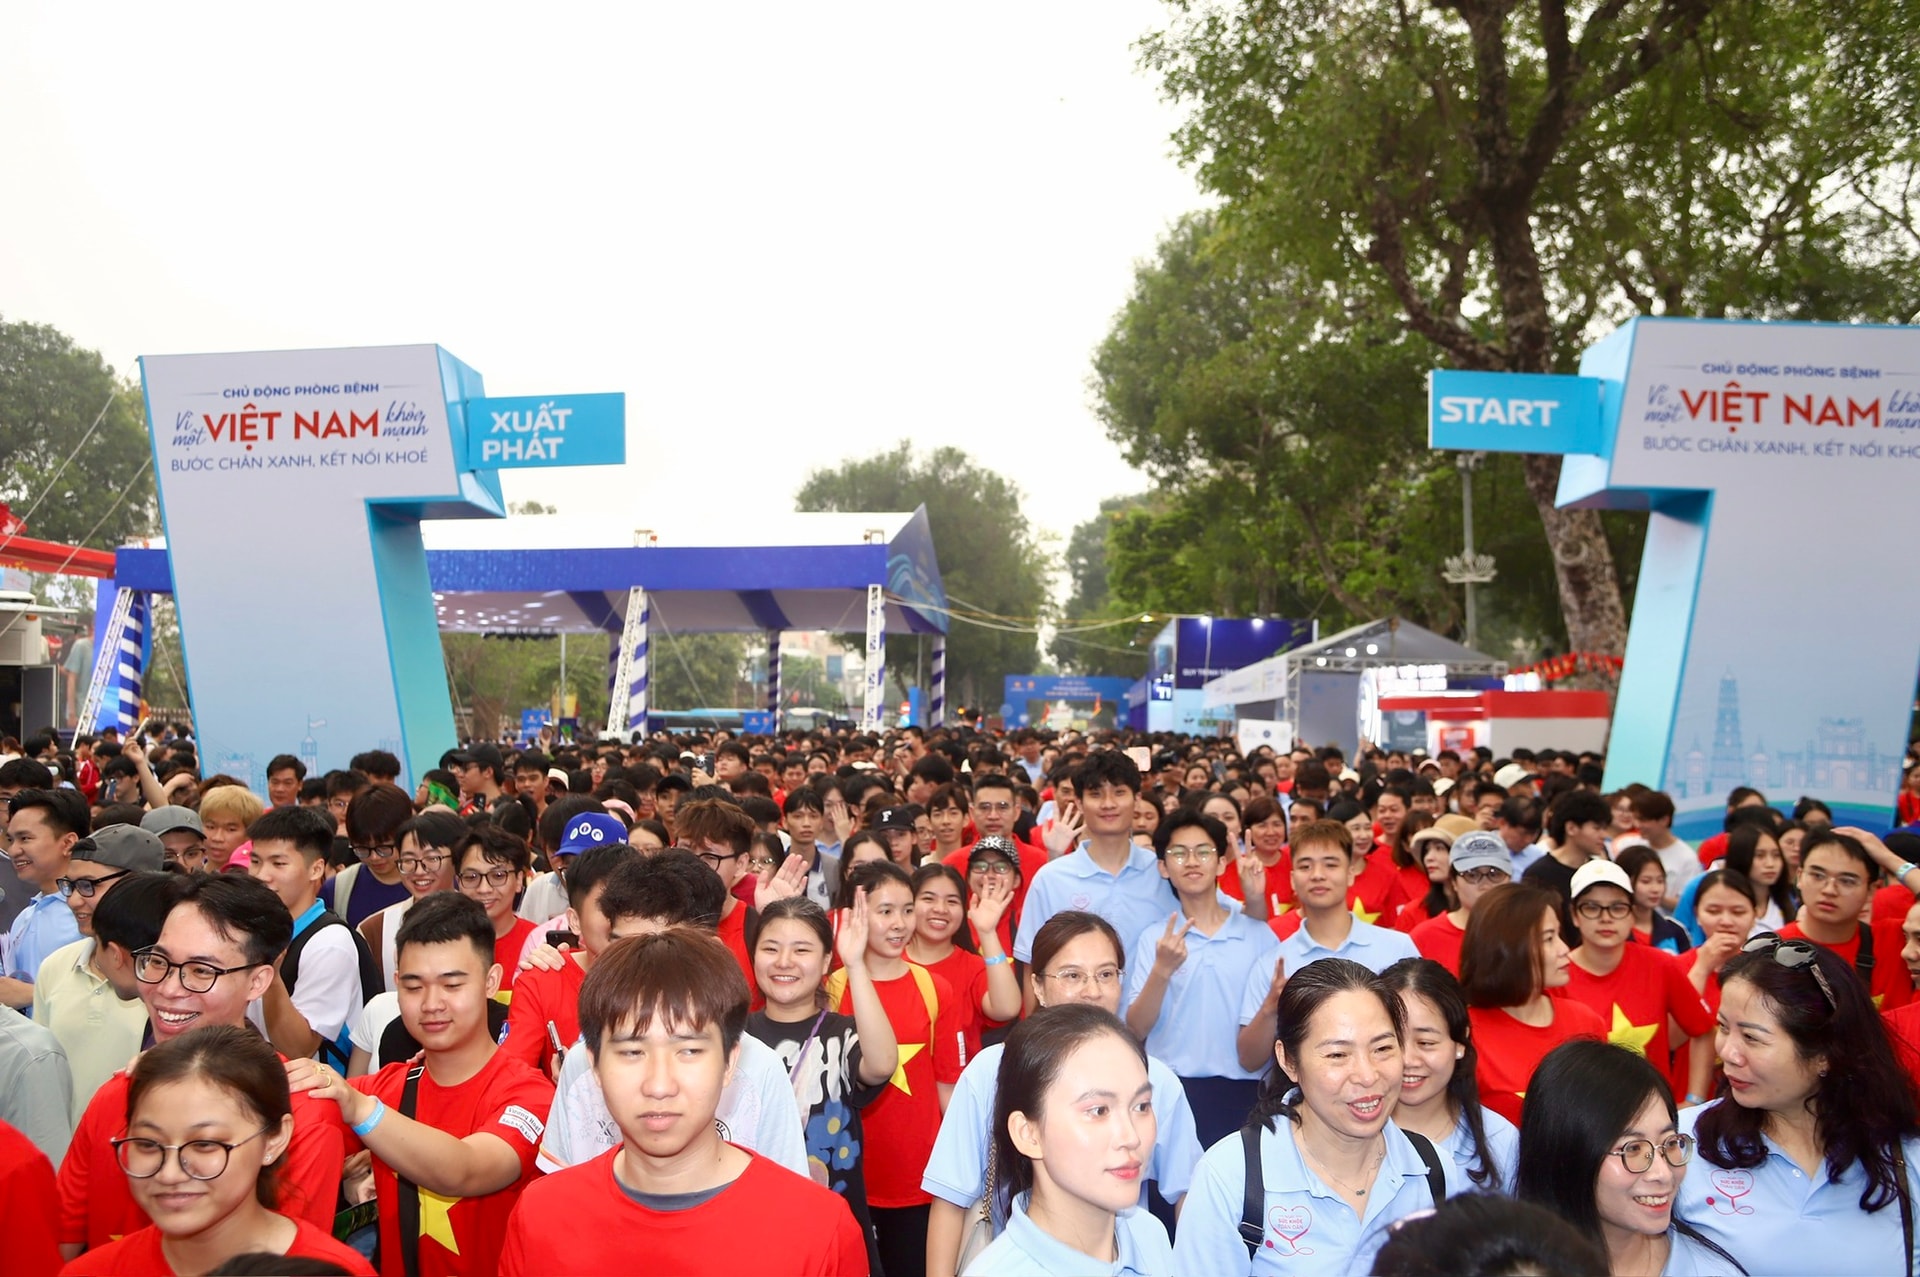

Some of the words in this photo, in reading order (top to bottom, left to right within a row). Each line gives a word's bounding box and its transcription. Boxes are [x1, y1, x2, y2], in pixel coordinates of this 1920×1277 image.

[1701, 361, 1732, 374] CHỦ
[1737, 363, 1779, 377] ĐỘNG
[1783, 364, 1835, 377] PHÒNG
[1840, 365, 1880, 379] BỆNH
[223, 385, 250, 398] CHỦ
[253, 385, 291, 399] ĐỘNG
[294, 382, 340, 395] PHÒNG
[344, 382, 379, 396] BỆNH
[1648, 383, 1669, 406] Vì
[1887, 389, 1920, 413] khỏ
[490, 401, 573, 433] XUẤT
[1440, 396, 1559, 427] START
[1679, 380, 1770, 433] VIỆT
[1783, 392, 1881, 428] NAM
[176, 410, 193, 431] Vì
[202, 402, 282, 451] VIỆT
[294, 408, 379, 440] NAM
[1884, 418, 1920, 434] mạn
[172, 427, 207, 451] một
[382, 424, 429, 442] mạnh
[482, 432, 564, 462] PHÁT
[1813, 438, 1845, 456] KẾT
[1849, 439, 1883, 457] NỐI
[1887, 444, 1920, 459] KHO
[171, 455, 214, 472] BƯỚC
[218, 454, 263, 470] CHÂN
[320, 449, 347, 466] KẾT
[352, 448, 380, 465] NỐI
